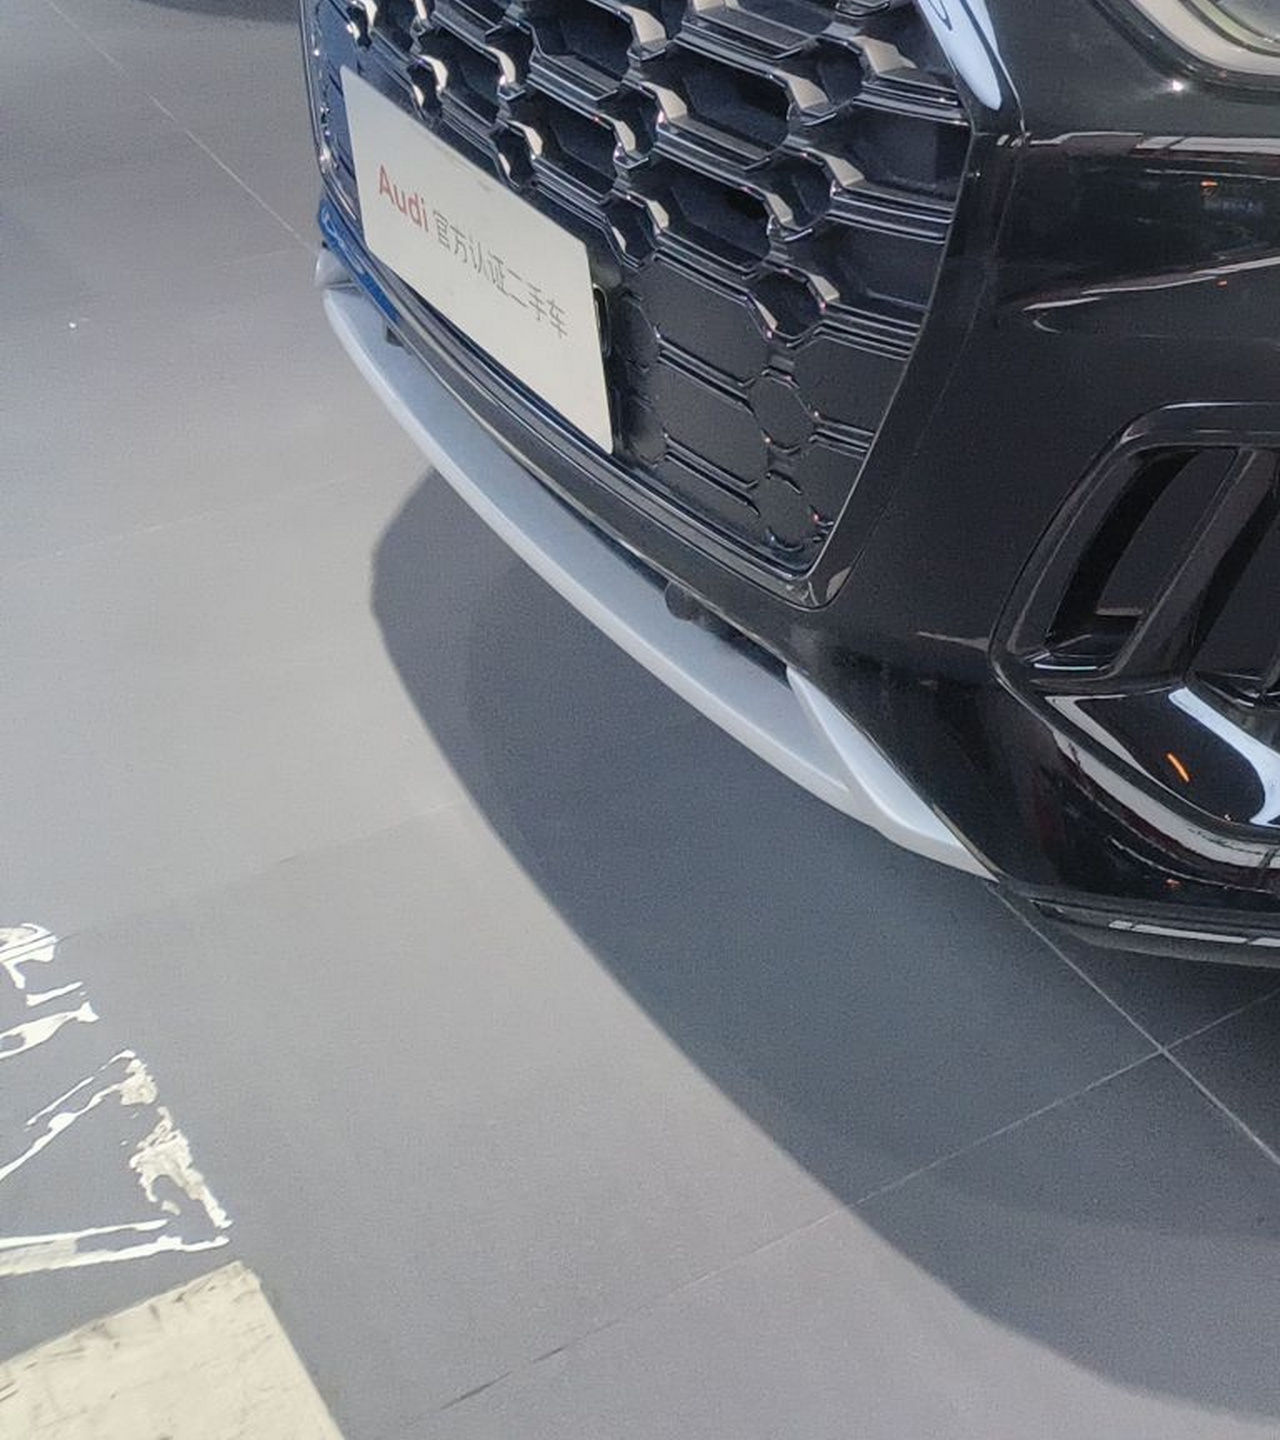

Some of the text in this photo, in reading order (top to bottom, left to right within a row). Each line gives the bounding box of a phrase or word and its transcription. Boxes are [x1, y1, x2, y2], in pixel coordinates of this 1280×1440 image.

[378, 164, 569, 338] Audi 官方认证二手车
